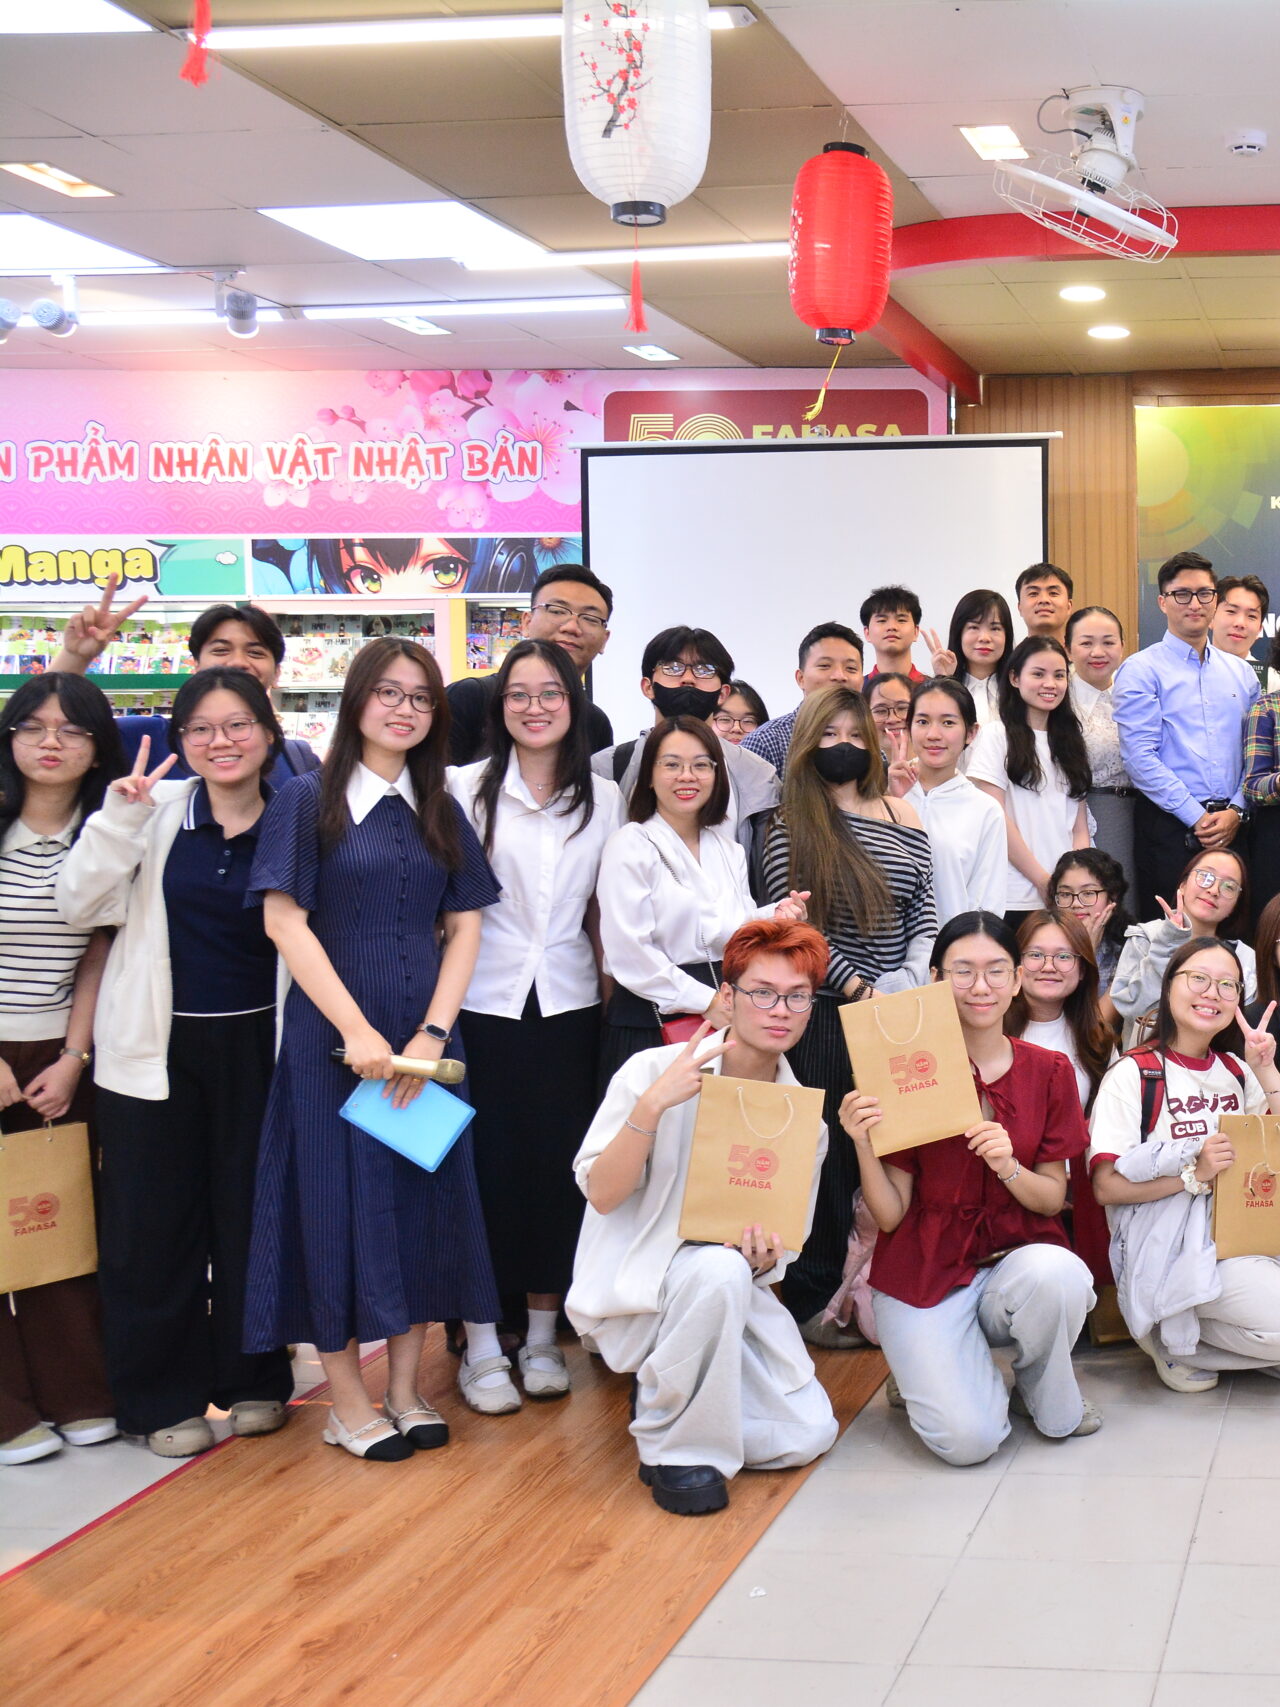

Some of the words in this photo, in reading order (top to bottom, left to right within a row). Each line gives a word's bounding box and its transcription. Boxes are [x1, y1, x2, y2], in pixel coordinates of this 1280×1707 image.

[30, 427, 136, 479] PHẨM
[154, 438, 249, 479] NHÂN
[267, 437, 340, 488] VẬT
[353, 434, 449, 489] NHẬT
[464, 430, 542, 480] BẢN
[0, 545, 156, 589] Manga
[889, 1050, 938, 1086] 50
[898, 1079, 939, 1095] FAHASA
[1174, 1123, 1206, 1136] CUB
[727, 1144, 779, 1180] 50
[729, 1177, 772, 1191] FAHASA
[1243, 1172, 1277, 1200] 50
[8, 1192, 60, 1228] 50
[1246, 1200, 1274, 1208] FAHASA
[14, 1221, 57, 1237] FAHASA
